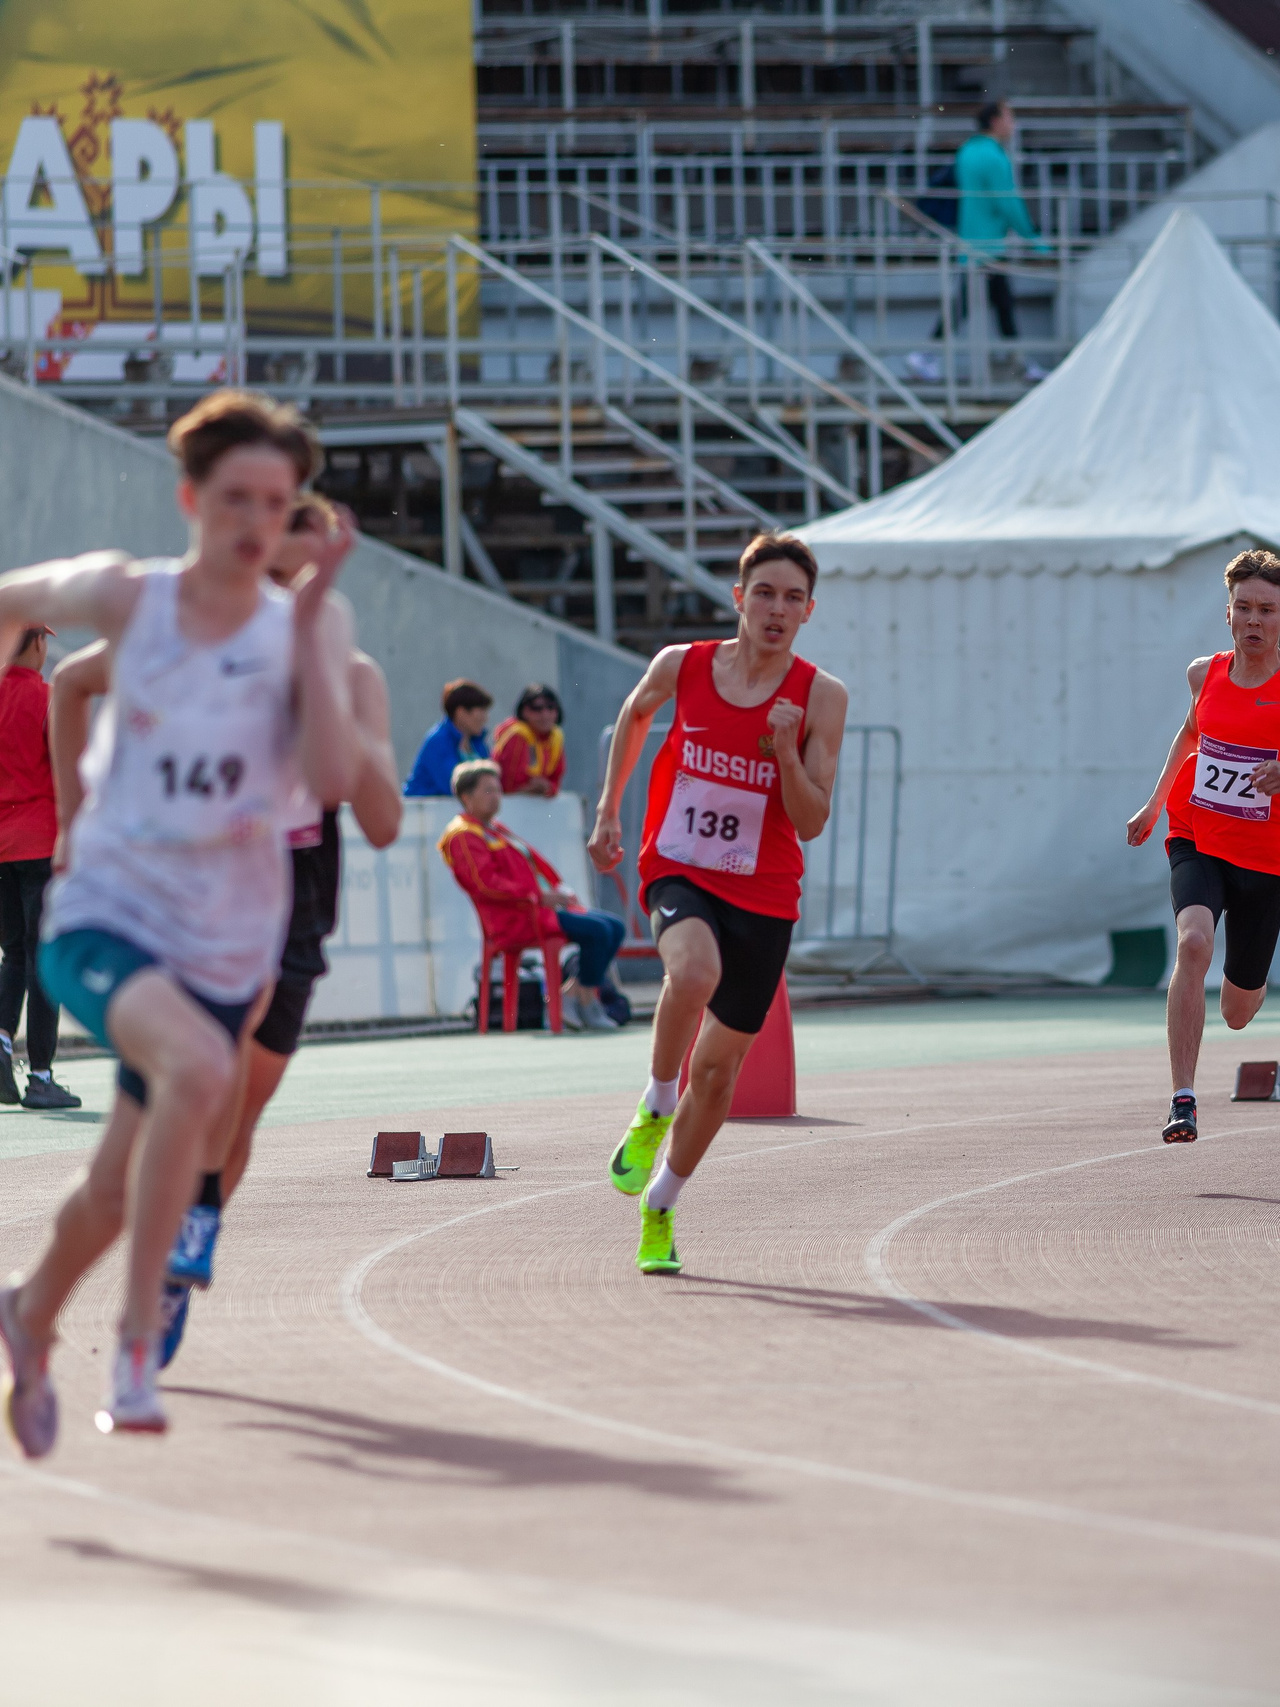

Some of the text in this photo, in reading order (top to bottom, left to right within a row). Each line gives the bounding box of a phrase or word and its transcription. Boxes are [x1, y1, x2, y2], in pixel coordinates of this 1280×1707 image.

[159, 754, 244, 801] 149
[682, 739, 777, 788] RUSSIA
[1204, 764, 1256, 799] 272
[684, 806, 740, 842] 138
